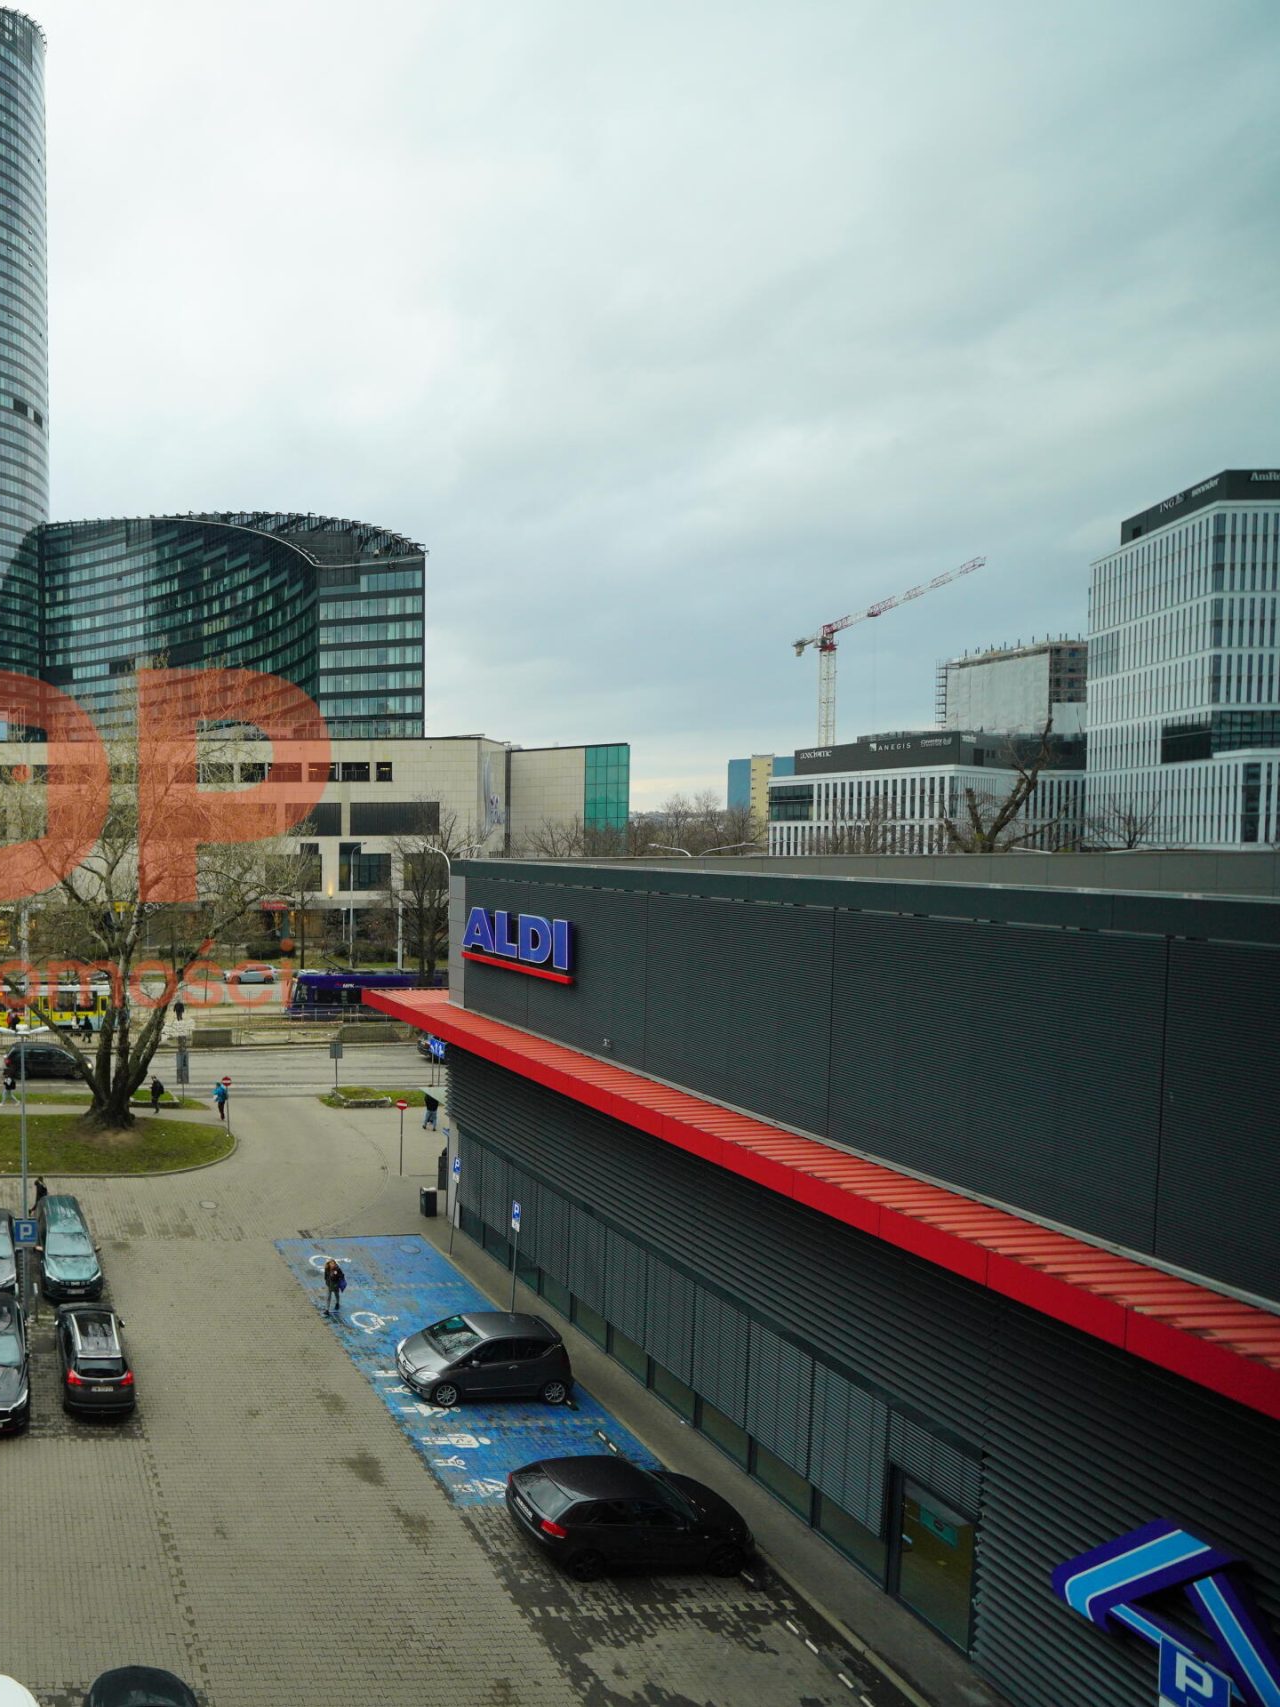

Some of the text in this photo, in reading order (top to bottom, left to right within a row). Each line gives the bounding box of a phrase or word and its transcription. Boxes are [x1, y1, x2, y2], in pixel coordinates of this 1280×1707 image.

[1159, 499, 1175, 513] ING
[878, 742, 912, 752] ANEGIS
[462, 906, 570, 972] ALDI
[19, 1223, 33, 1240] P
[1175, 1651, 1213, 1698] P
